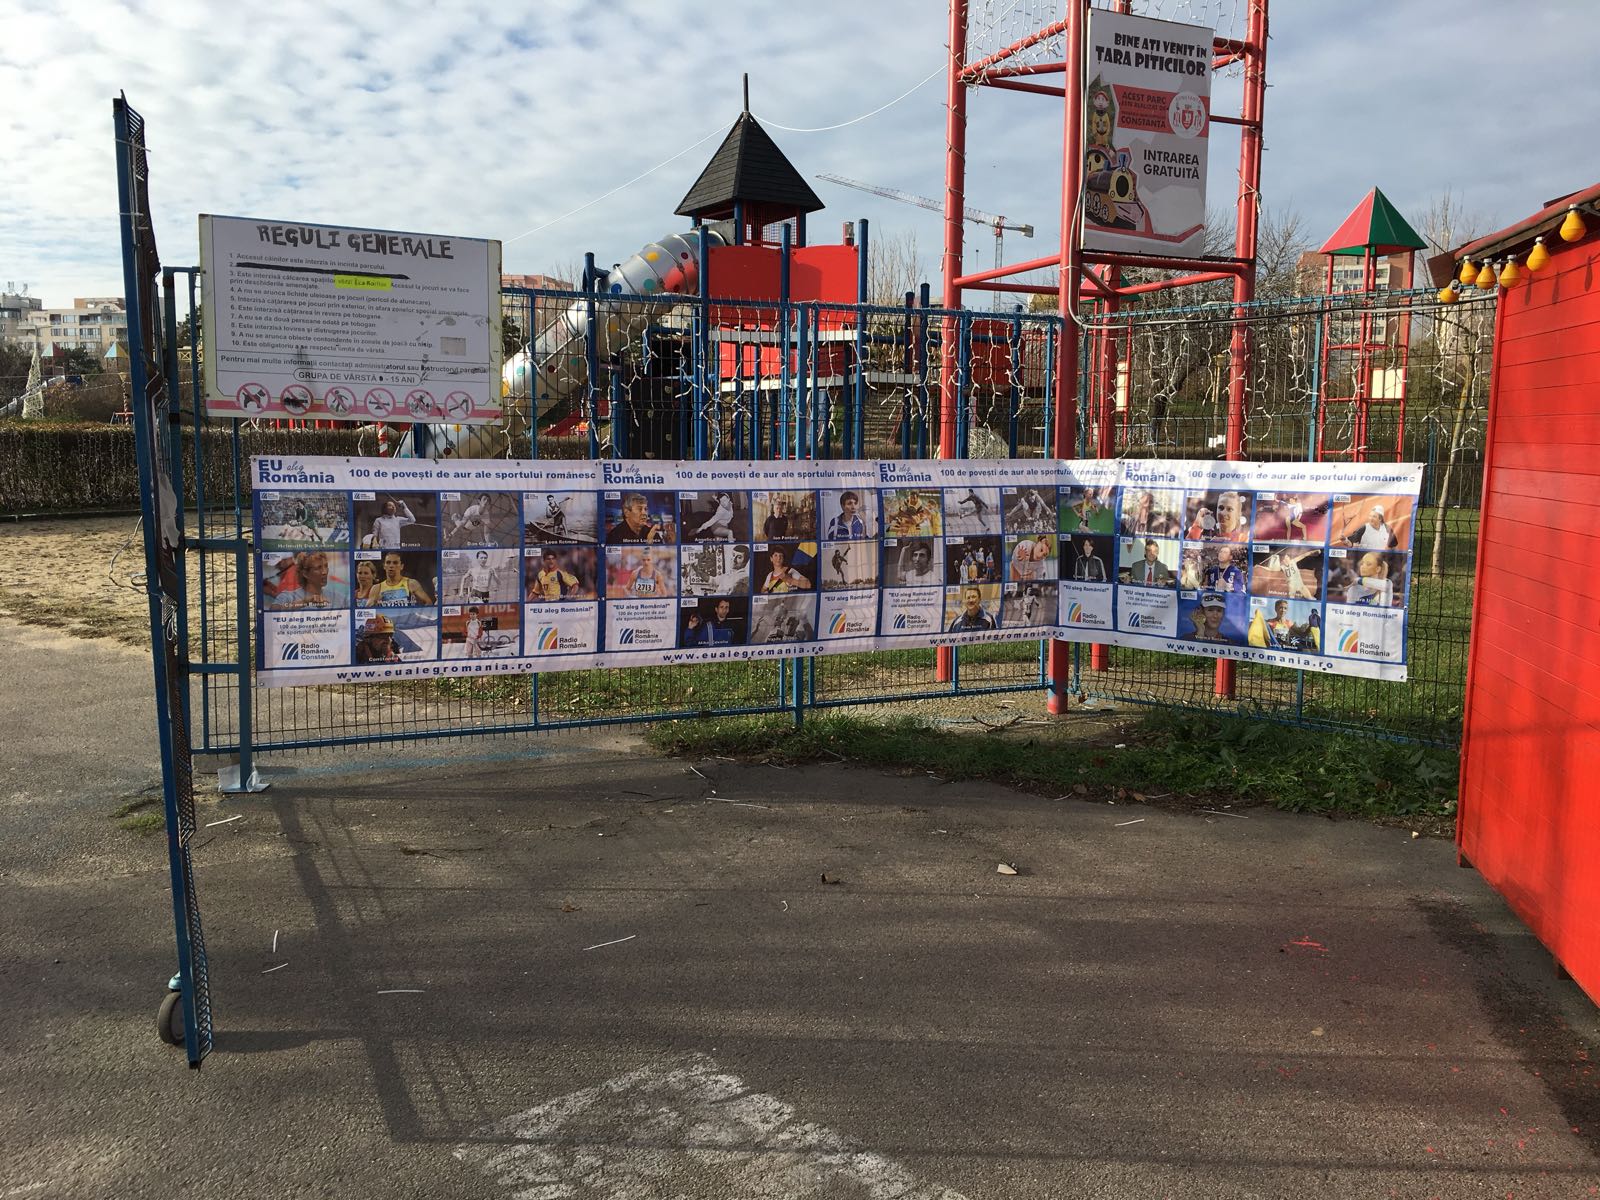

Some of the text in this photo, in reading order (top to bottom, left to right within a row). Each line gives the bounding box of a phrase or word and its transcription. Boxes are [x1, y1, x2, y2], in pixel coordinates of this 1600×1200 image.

[1114, 32, 1141, 49] BINE
[1162, 40, 1195, 57] VENIT
[1134, 52, 1207, 77] PITICILOR
[1143, 149, 1200, 166] INTRAREA
[1143, 163, 1200, 180] GRATUITĂ
[256, 224, 455, 260] REGULI GENERALE
[298, 371, 328, 380] GRUPA
[329, 373, 341, 381] DE
[258, 459, 283, 471] EU
[602, 462, 623, 474] EU
[879, 463, 896, 473] EU
[1125, 462, 1142, 472] EU
[258, 471, 335, 484] România
[349, 468, 370, 478] 100
[373, 469, 388, 478] de
[436, 470, 450, 479] de
[453, 471, 472, 479] aur
[474, 470, 492, 479] ale
[495, 470, 543, 481] sportului
[675, 470, 693, 479] 100
[696, 471, 708, 479] de
[748, 470, 761, 479] de
[781, 470, 795, 478] ale
[797, 470, 835, 480] sportului
[880, 472, 932, 483] România
[940, 469, 955, 477] 100
[957, 468, 967, 476] de
[998, 468, 1009, 476] de
[1026, 468, 1039, 476] ale
[1125, 471, 1176, 482] România
[1206, 471, 1217, 479] de
[1255, 472, 1268, 480] de
[1290, 472, 1306, 481] ale
[1309, 473, 1357, 483] sportului
[603, 473, 665, 485] România
[636, 583, 652, 592] 2713
[1359, 641, 1380, 650] Radio
[662, 646, 825, 661] www.eualegromania.ro
[1166, 642, 1334, 669] www.eualegromania.ro
[336, 661, 533, 680] www.eualegromania.ro
